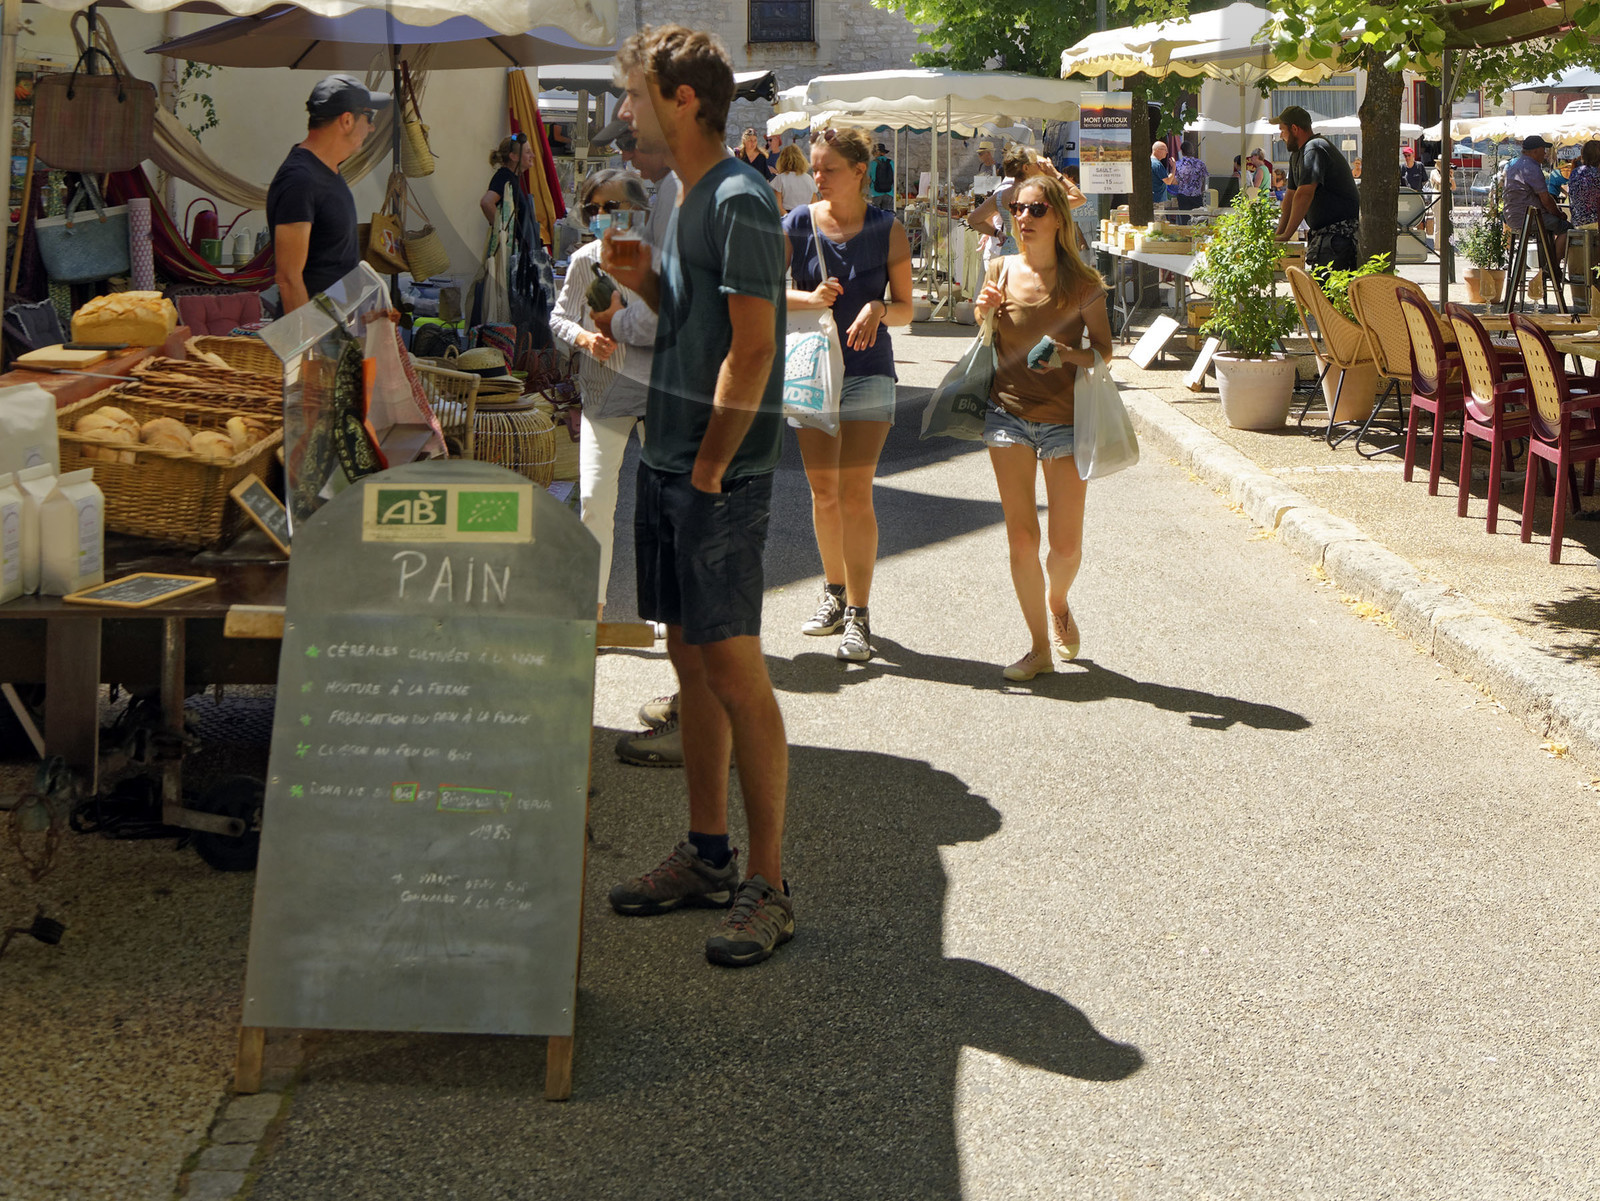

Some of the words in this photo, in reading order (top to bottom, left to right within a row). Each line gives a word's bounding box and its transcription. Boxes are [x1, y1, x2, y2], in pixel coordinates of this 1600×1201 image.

[1083, 116, 1100, 124] MONT
[1101, 116, 1128, 124] VENTOUX
[958, 398, 978, 412] Bio
[381, 499, 438, 525] AB
[407, 683, 424, 696] LA
[427, 681, 471, 696] FERME
